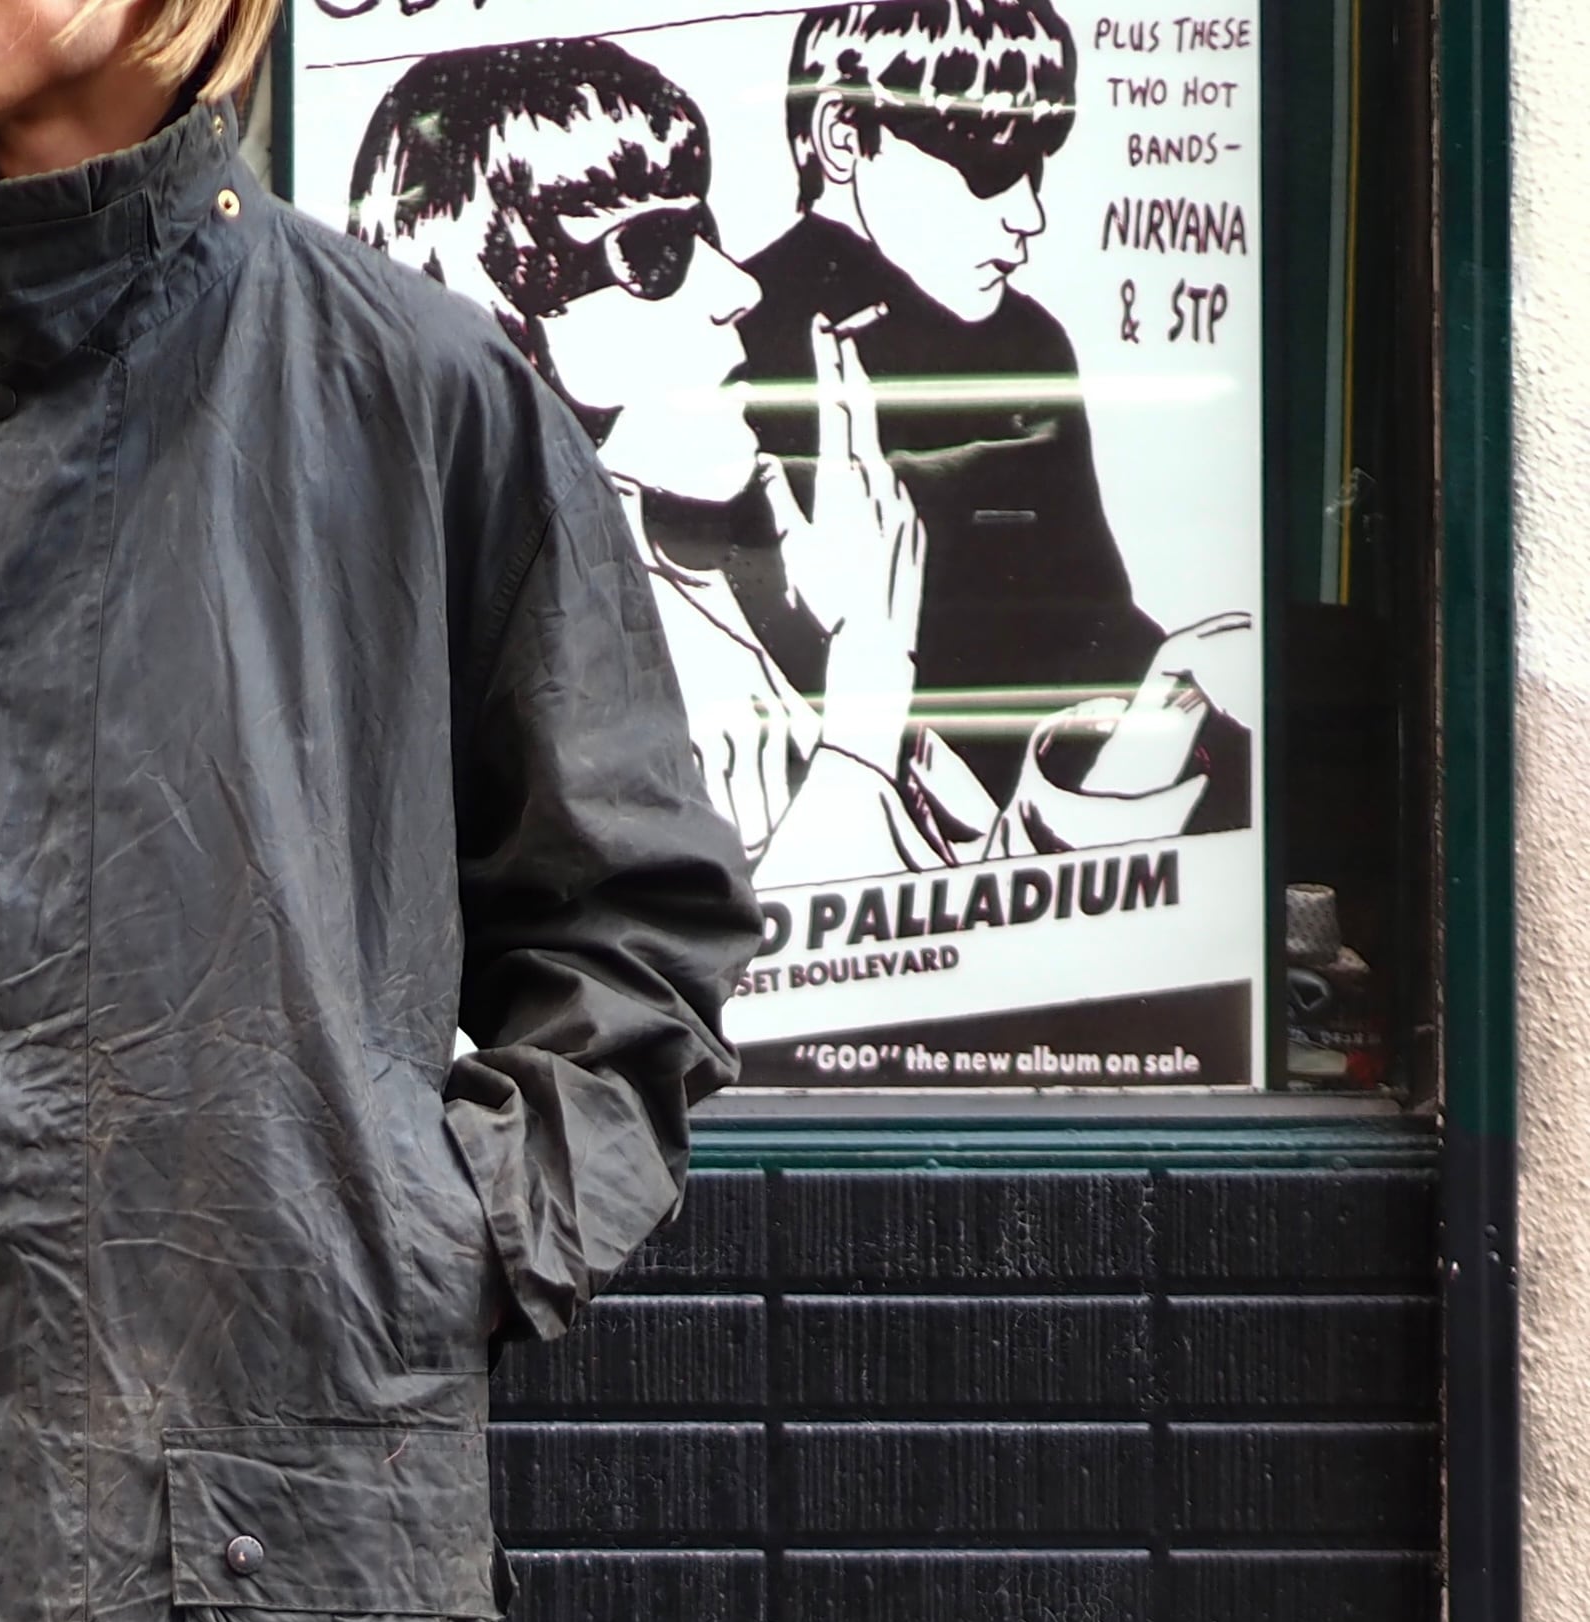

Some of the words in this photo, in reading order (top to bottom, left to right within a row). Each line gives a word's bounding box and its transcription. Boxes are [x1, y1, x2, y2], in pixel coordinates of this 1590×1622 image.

[1094, 17, 1160, 53] PLUS
[1173, 16, 1251, 53] THESE
[1107, 77, 1167, 108] TWO
[1183, 76, 1238, 108] HOT
[1101, 196, 1248, 256] NIRVANA
[1120, 278, 1140, 344] &
[1168, 278, 1228, 344] STP
[807, 849, 1179, 950] PALLADIUM
[789, 945, 959, 989] BOULEVARD
[905, 1044, 950, 1071] the
[954, 1051, 1010, 1072] new
[1016, 1045, 1101, 1073] album
[1105, 1053, 1140, 1073] on
[1144, 1046, 1200, 1073] sale
